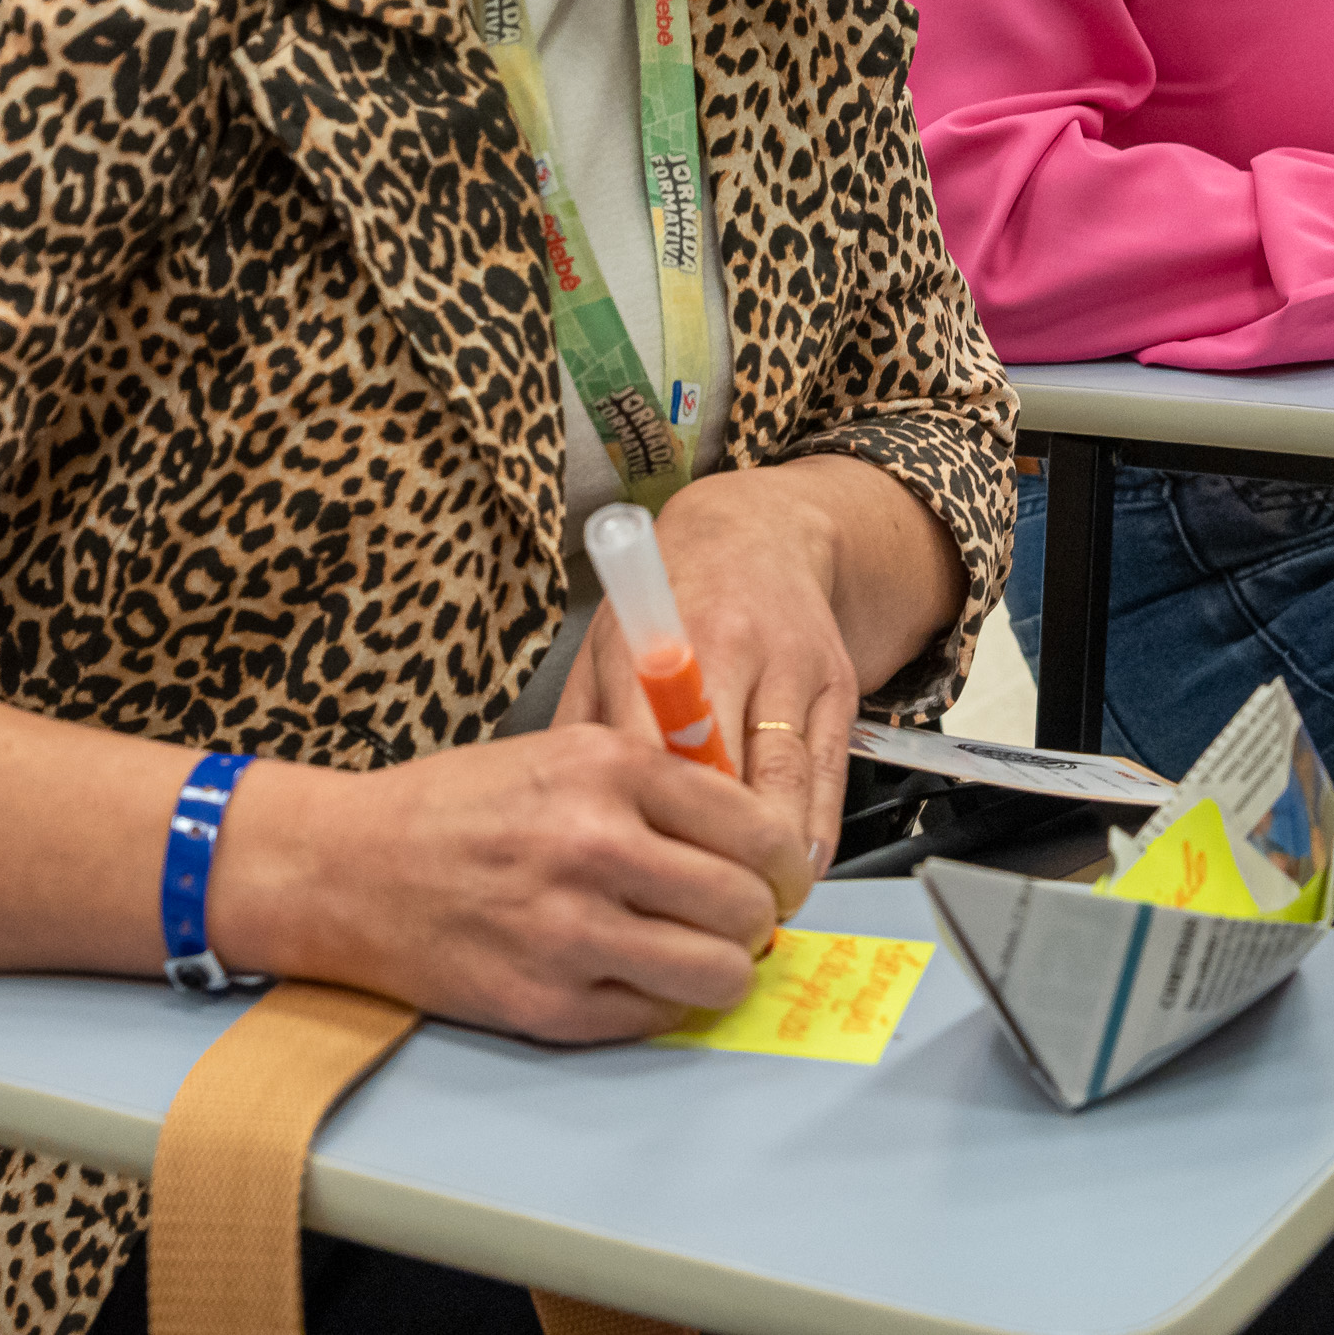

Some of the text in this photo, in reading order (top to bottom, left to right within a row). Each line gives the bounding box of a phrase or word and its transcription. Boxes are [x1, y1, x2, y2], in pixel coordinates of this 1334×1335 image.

[651, 153, 680, 268] FORMATIVA
[668, 152, 698, 274] JORNADA
[610, 386, 674, 475] JORNADA
